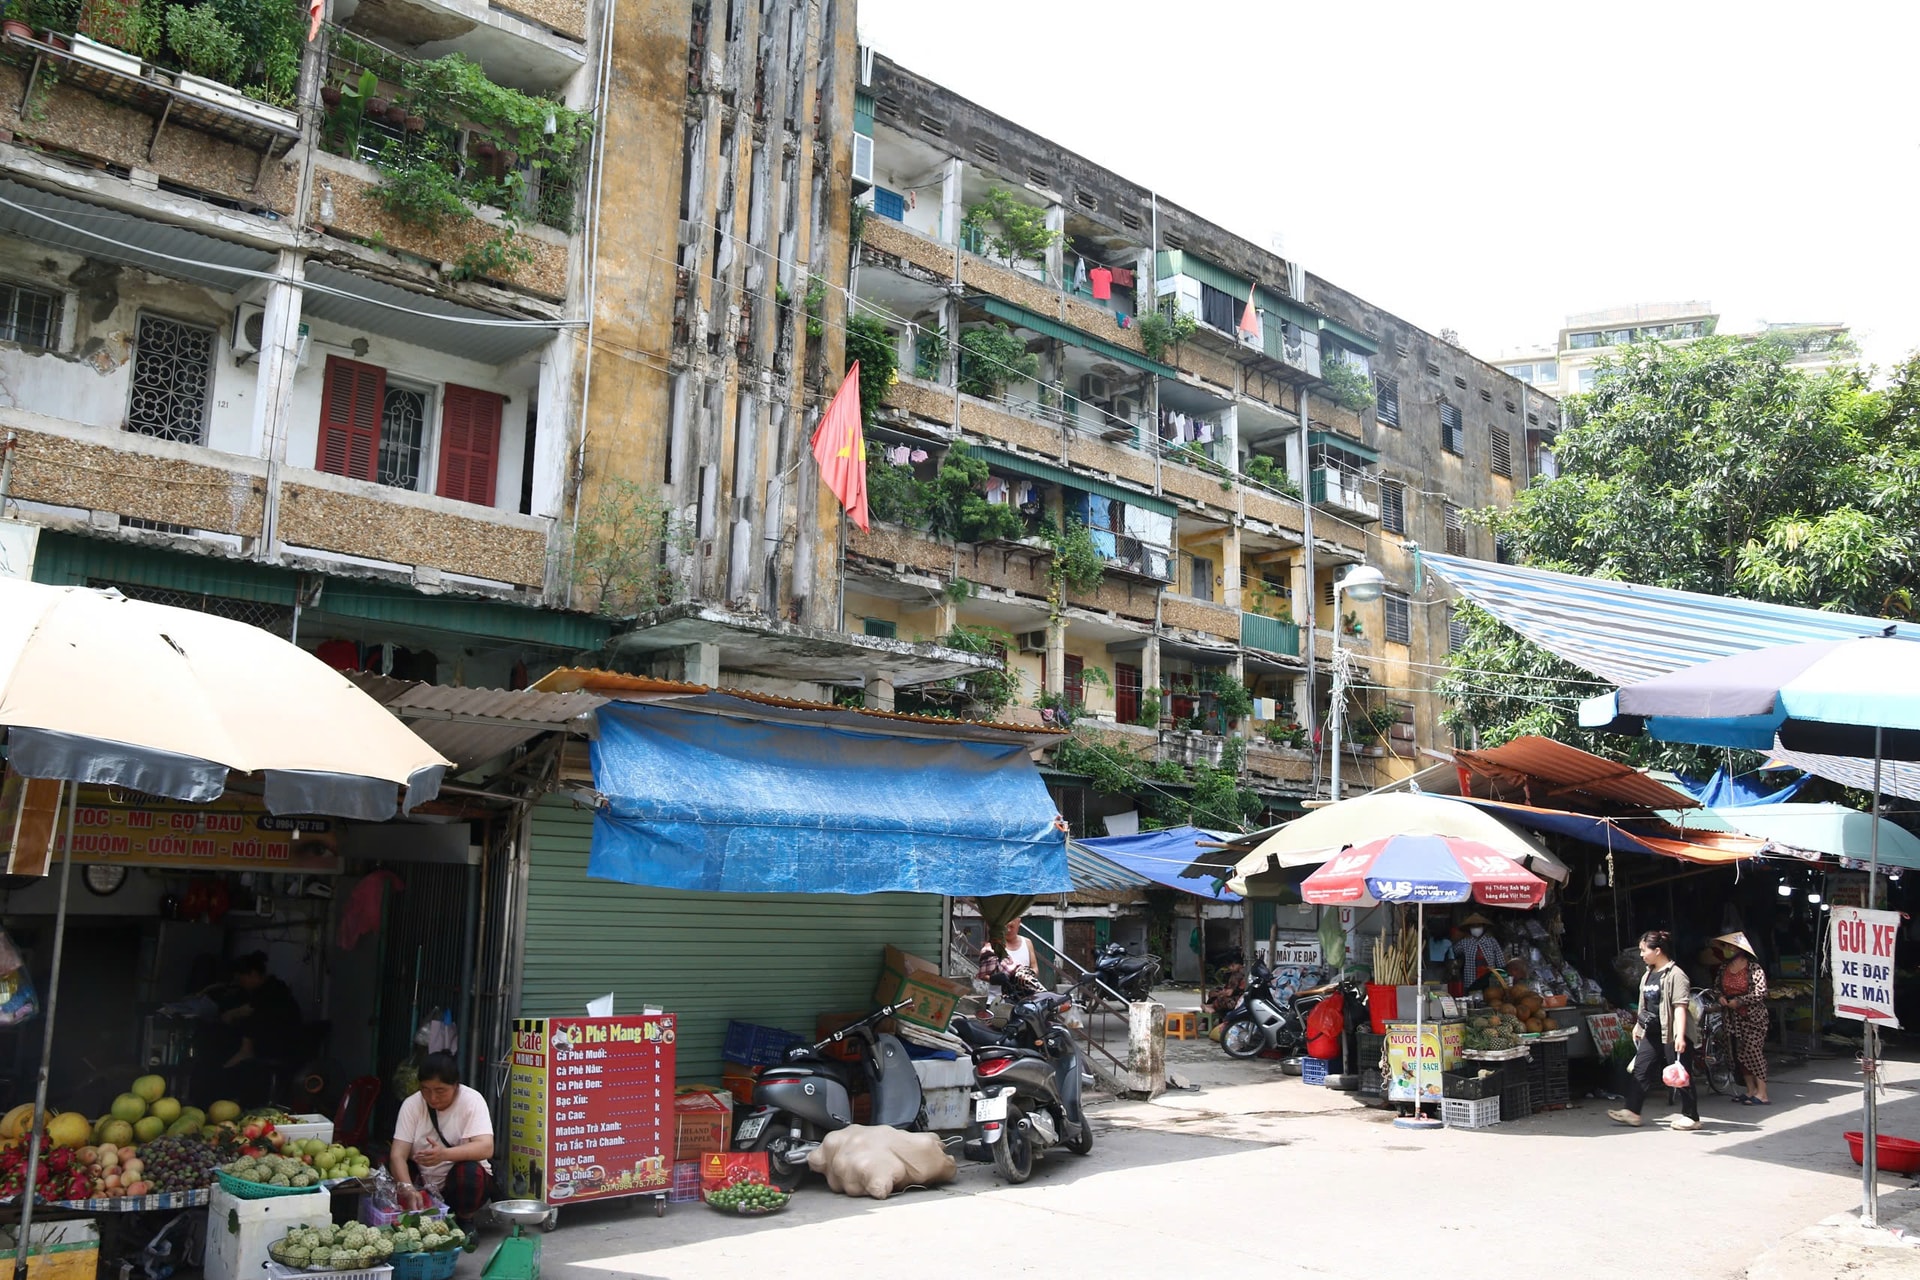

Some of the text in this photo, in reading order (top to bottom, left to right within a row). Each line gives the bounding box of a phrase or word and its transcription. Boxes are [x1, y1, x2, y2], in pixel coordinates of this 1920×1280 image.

[218, 400, 229, 408] 121
[128, 811, 153, 827] MI
[57, 833, 130, 855] NHUỘM
[148, 833, 186, 854] UỐN
[192, 839, 214, 856] MI
[232, 836, 262, 857] NỐI
[267, 843, 288, 858] MI
[1376, 881, 1412, 897] VUS
[1838, 911, 1867, 954] GỬI
[1293, 950, 1304, 963] XE
[1304, 950, 1318, 965] ĐẠP
[1842, 960, 1859, 977] XE
[1841, 982, 1858, 999] XE
[585, 1024, 607, 1044] Phê
[610, 1023, 642, 1044] Mang
[569, 1050, 584, 1060] Phê
[655, 1045, 660, 1054] k
[1407, 1044, 1436, 1058] MÍA
[556, 1059, 660, 1076] Cà Phê Nâu: k
[1423, 1062, 1439, 1072] SẠCH
[556, 1074, 660, 1091] Cà Phê Đen: k
[556, 1097, 571, 1108] Bạc
[655, 1088, 660, 1097] k
[556, 1103, 660, 1121] Ca Cao: k
[555, 1117, 660, 1137] Matcha Trà Xanh: k
[555, 1142, 568, 1152] Trà
[585, 1138, 598, 1148] Trà
[599, 1136, 625, 1146] Chanh:
[655, 1132, 660, 1141] k
[578, 1155, 595, 1164] Cam
[655, 1146, 660, 1155] k
